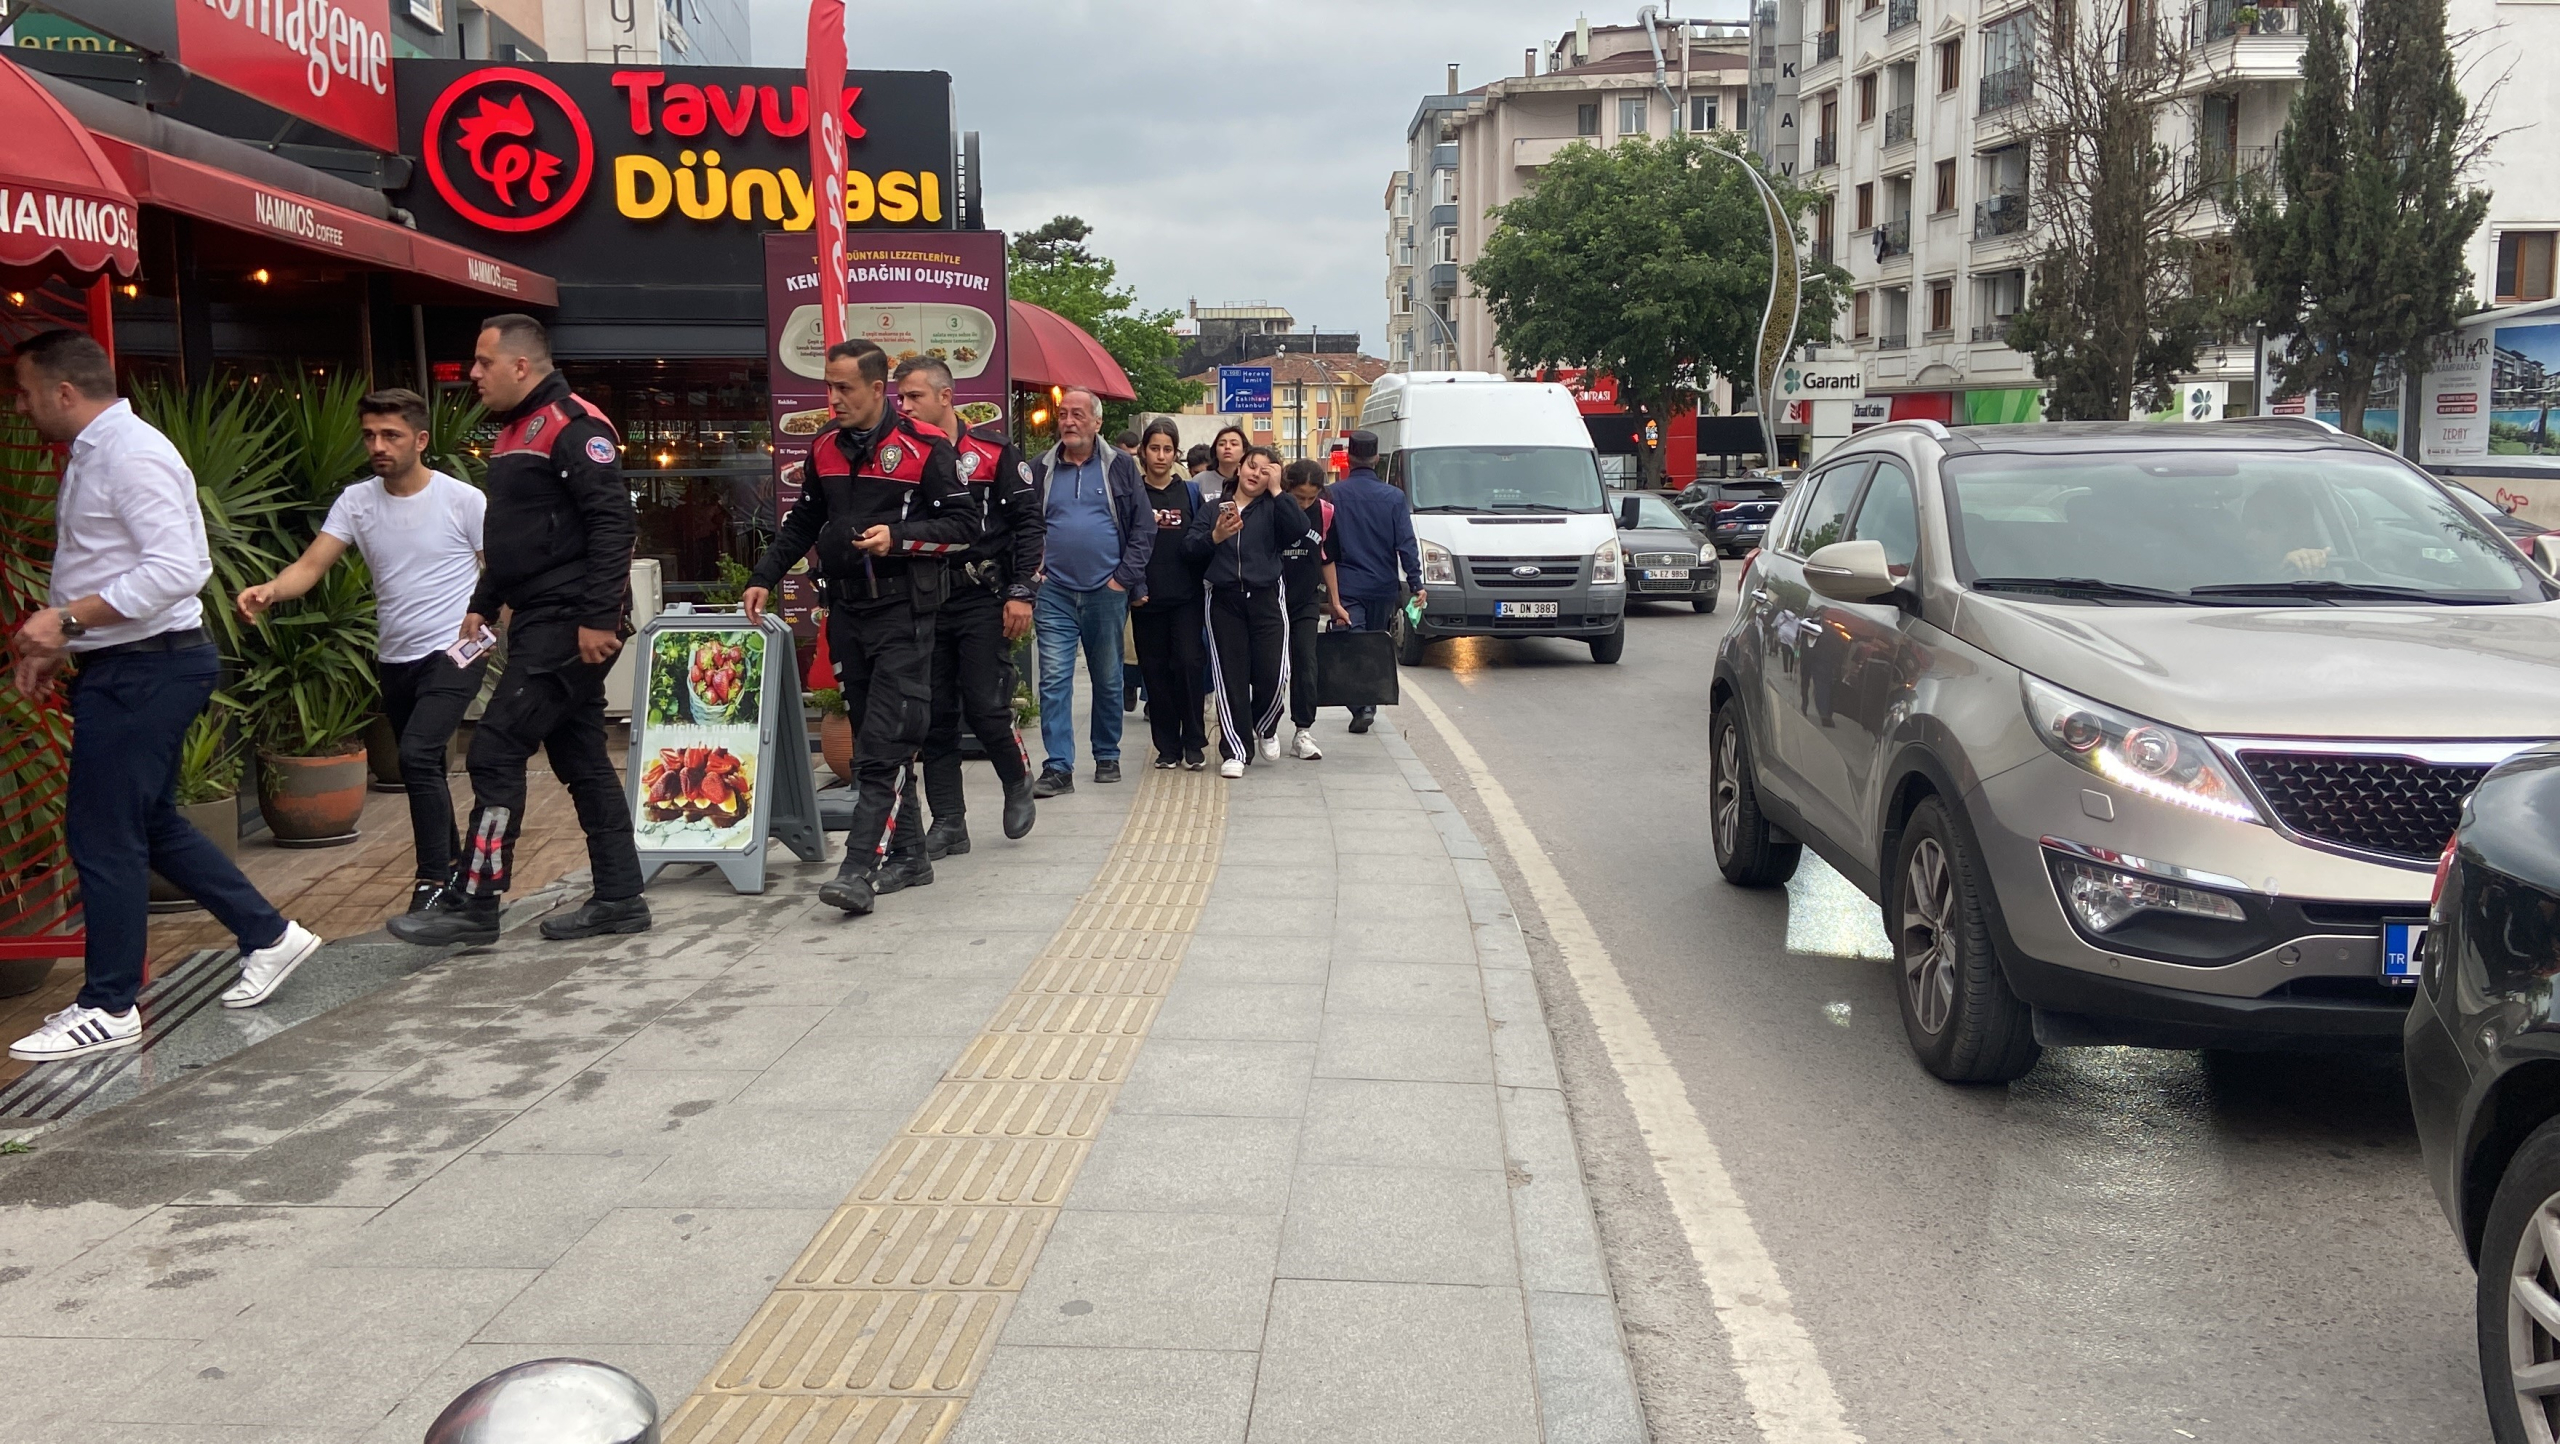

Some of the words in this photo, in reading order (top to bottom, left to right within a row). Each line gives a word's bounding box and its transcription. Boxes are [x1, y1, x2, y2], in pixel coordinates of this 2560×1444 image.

[615, 149, 942, 231] Dünyası
[255, 191, 315, 238] NAMMOS
[316, 225, 343, 247] COFFEE
[846, 250, 888, 262] DÜNYASI
[890, 251, 961, 265] LEZZETLERİYLE
[468, 257, 501, 288] NAMMOS
[786, 273, 821, 292] KEN
[847, 263, 911, 283] ABAĞINI
[914, 267, 990, 292] OLUŞTUR!
[882, 315, 890, 327] 2
[951, 317, 958, 328] 3
[1803, 372, 1860, 389] Garanti
[1503, 604, 1514, 613] 34
[1520, 604, 1531, 613] DN
[1535, 604, 1557, 613] 3883
[2388, 953, 2405, 965] TR
